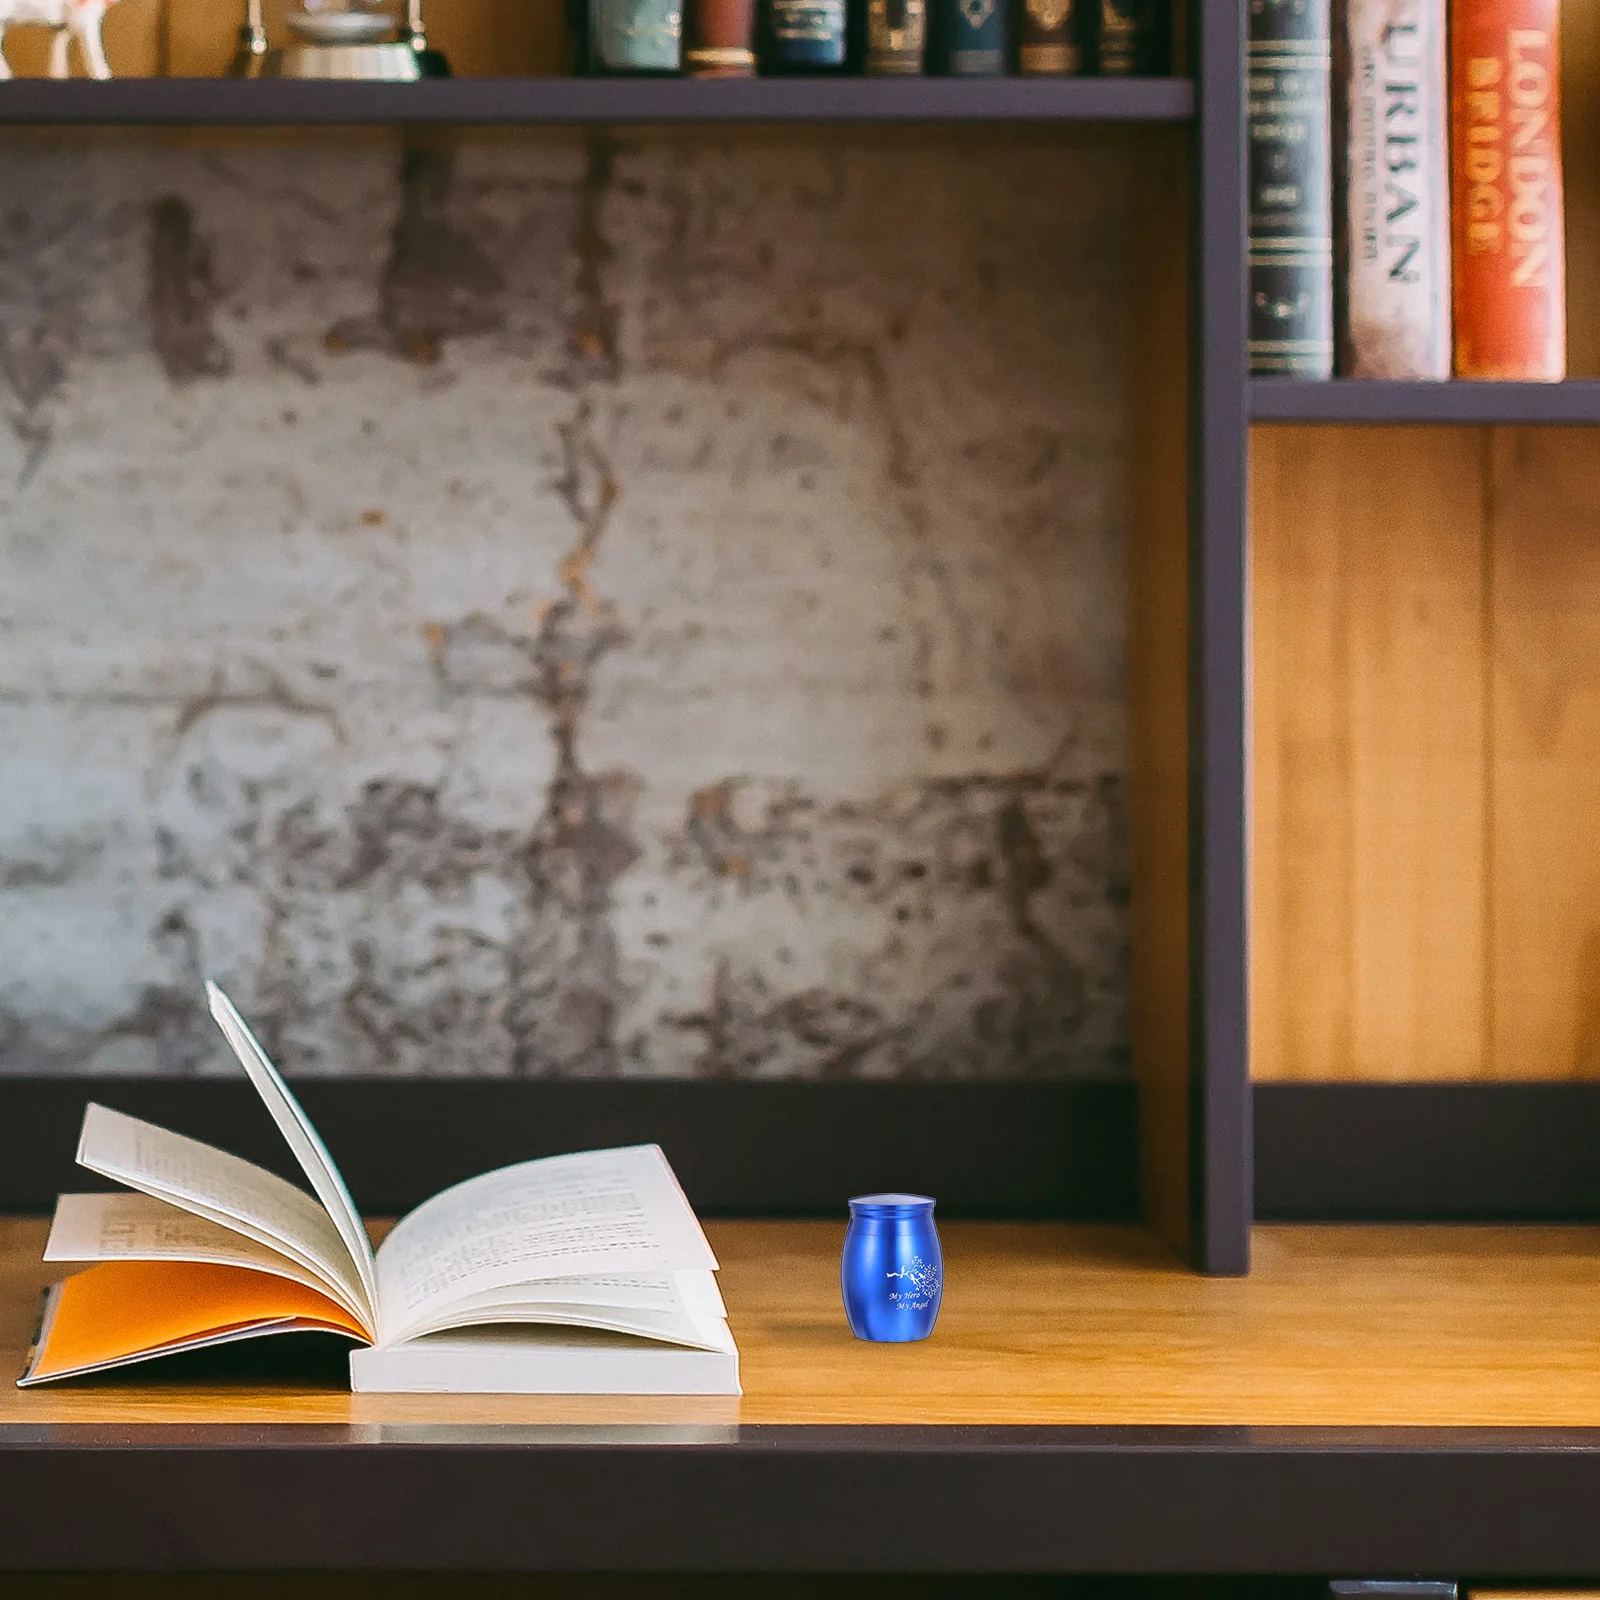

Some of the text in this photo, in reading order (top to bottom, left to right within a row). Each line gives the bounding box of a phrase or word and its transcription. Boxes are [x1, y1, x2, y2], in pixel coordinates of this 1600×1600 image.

[1383, 22, 1421, 284] URBAN
[1466, 57, 1502, 252] BRIDGE
[1508, 29, 1549, 288] LONDON
[889, 1291, 921, 1302] My Hero
[896, 1299, 930, 1312] My Angel
